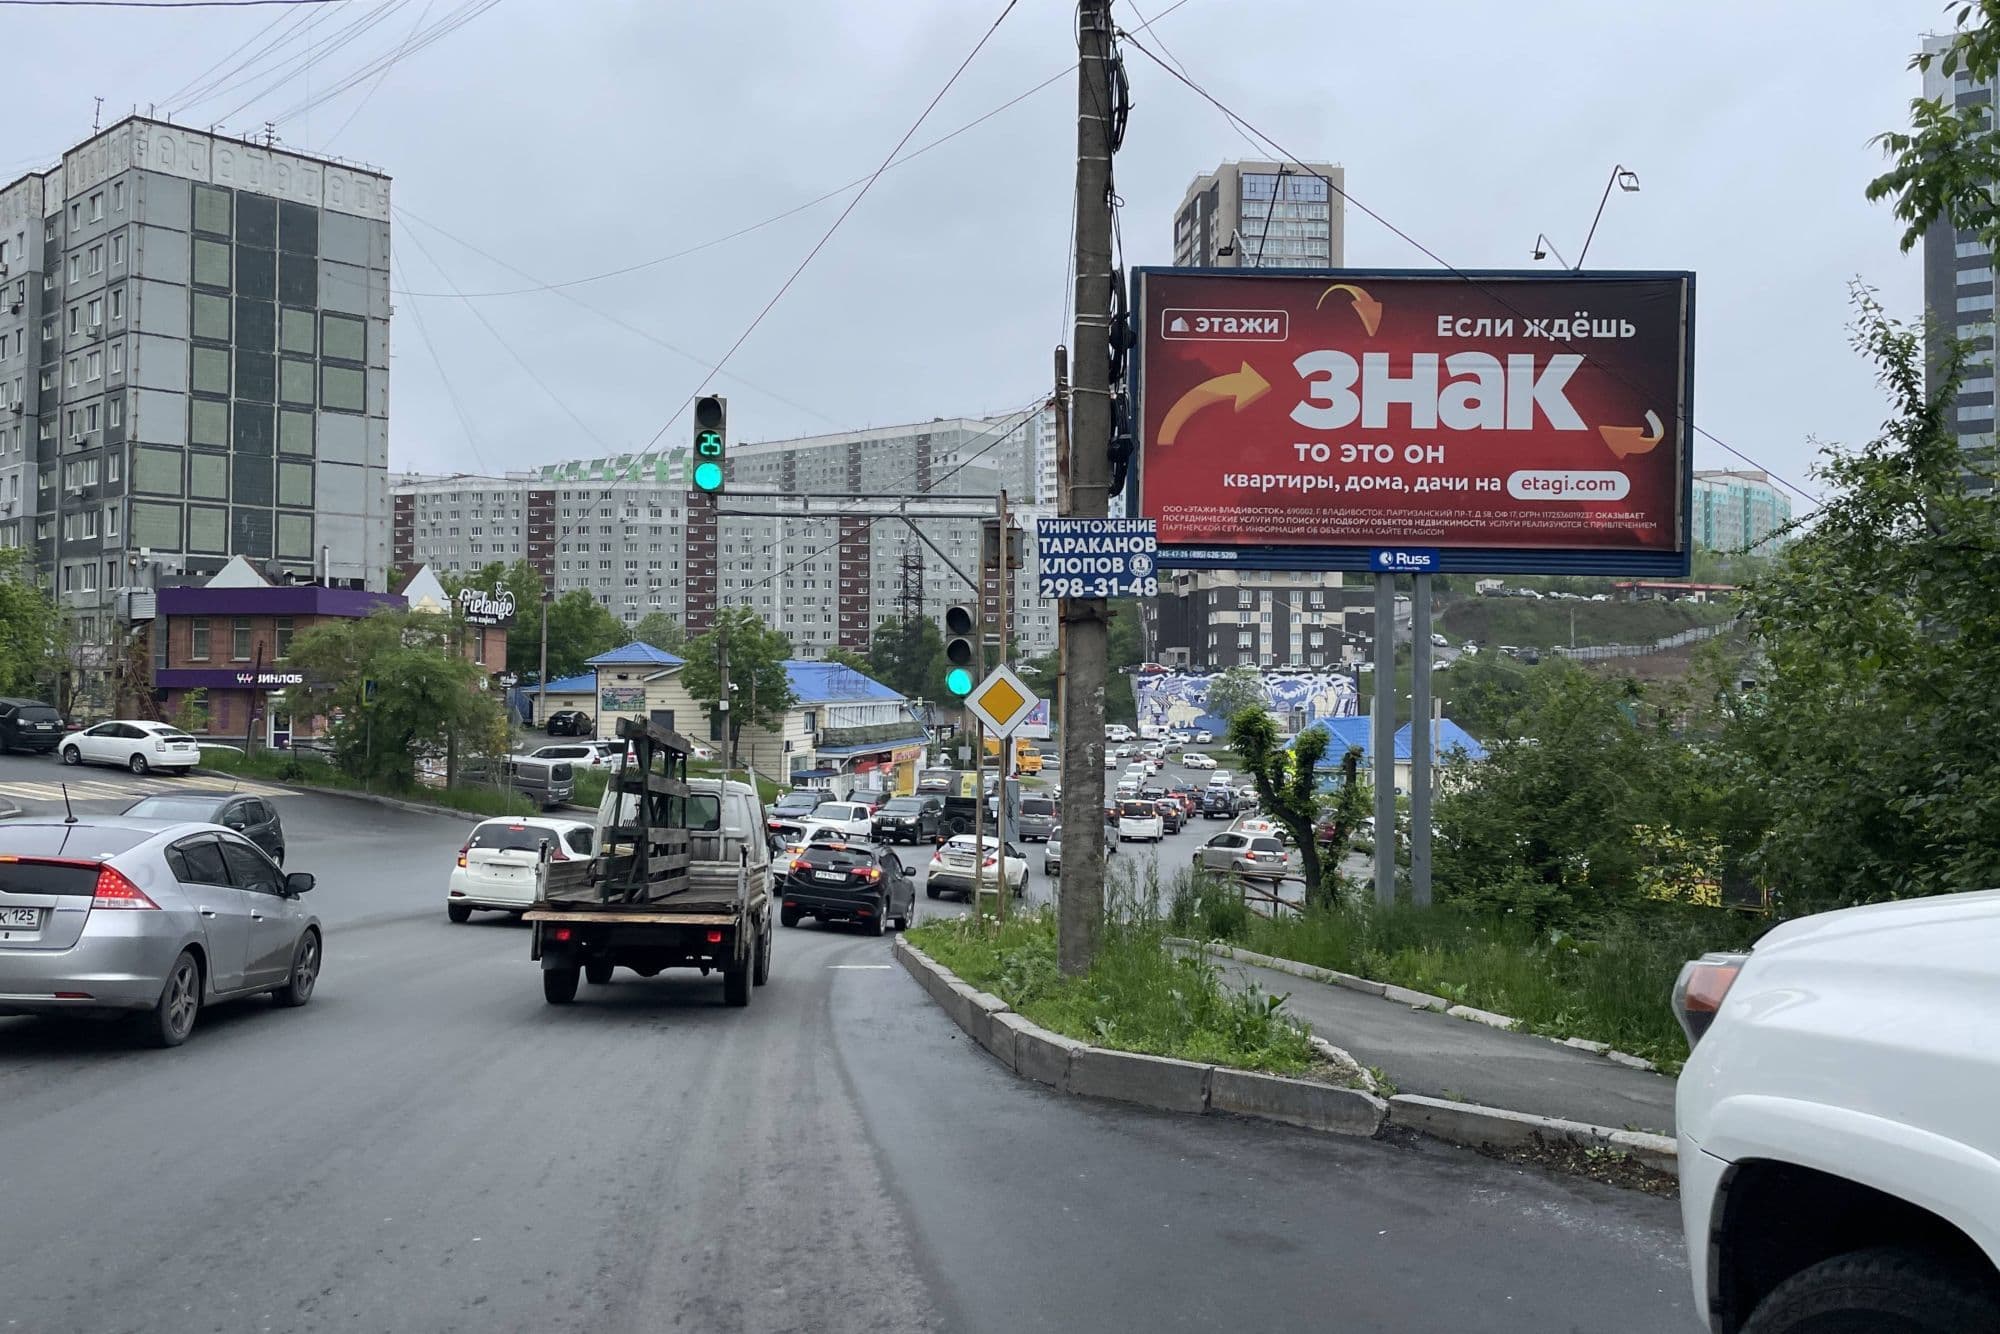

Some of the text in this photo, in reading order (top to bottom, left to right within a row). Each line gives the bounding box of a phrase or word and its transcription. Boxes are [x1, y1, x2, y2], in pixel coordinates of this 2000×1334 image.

[1437, 311, 1636, 341] Если ждёшь
[700, 433, 720, 455] 25
[1223, 473, 1501, 493] квартиры, дома, дачи на
[1521, 474, 1616, 495] etagi.com
[1162, 505, 1182, 513] ООО
[1038, 519, 1157, 534] УНИЧТОЖЕНИЕ
[1272, 516, 1285, 524] ПО
[1286, 516, 1320, 525] ПОИСКУ
[1039, 536, 1158, 554] ТАРАКАНОВ
[1039, 557, 1124, 575] КЛОПОВ
[1396, 552, 1431, 565] Russ
[1040, 577, 1158, 598] 298-31-48
[12, 909, 34, 920] 125
